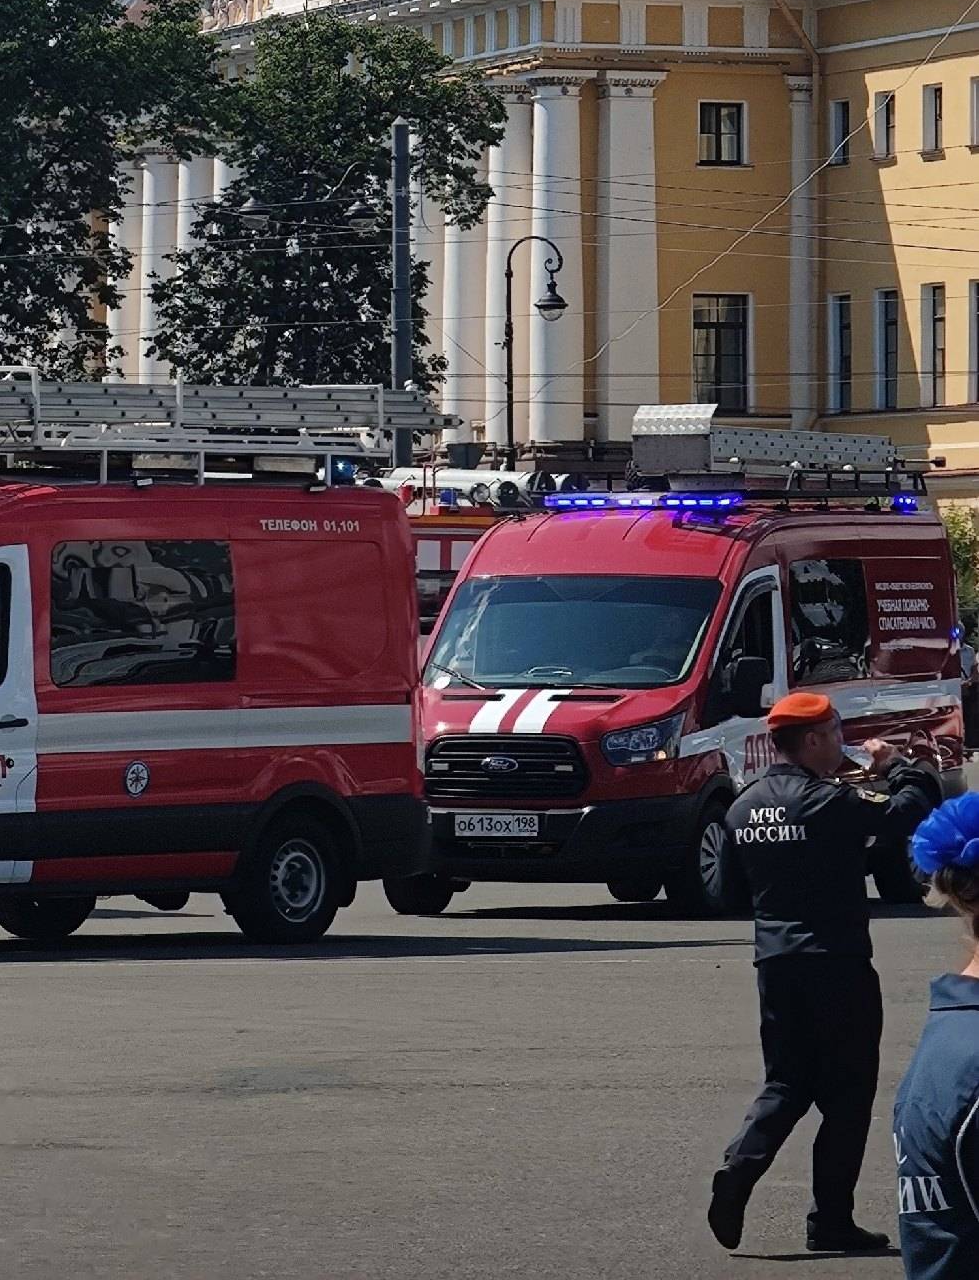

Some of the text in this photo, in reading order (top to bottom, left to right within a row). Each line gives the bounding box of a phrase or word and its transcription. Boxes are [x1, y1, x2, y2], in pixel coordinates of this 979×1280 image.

[259, 519, 318, 531] ТЕЛЕФОН
[748, 806, 786, 824] МЧС
[734, 825, 807, 845] РОССИИ
